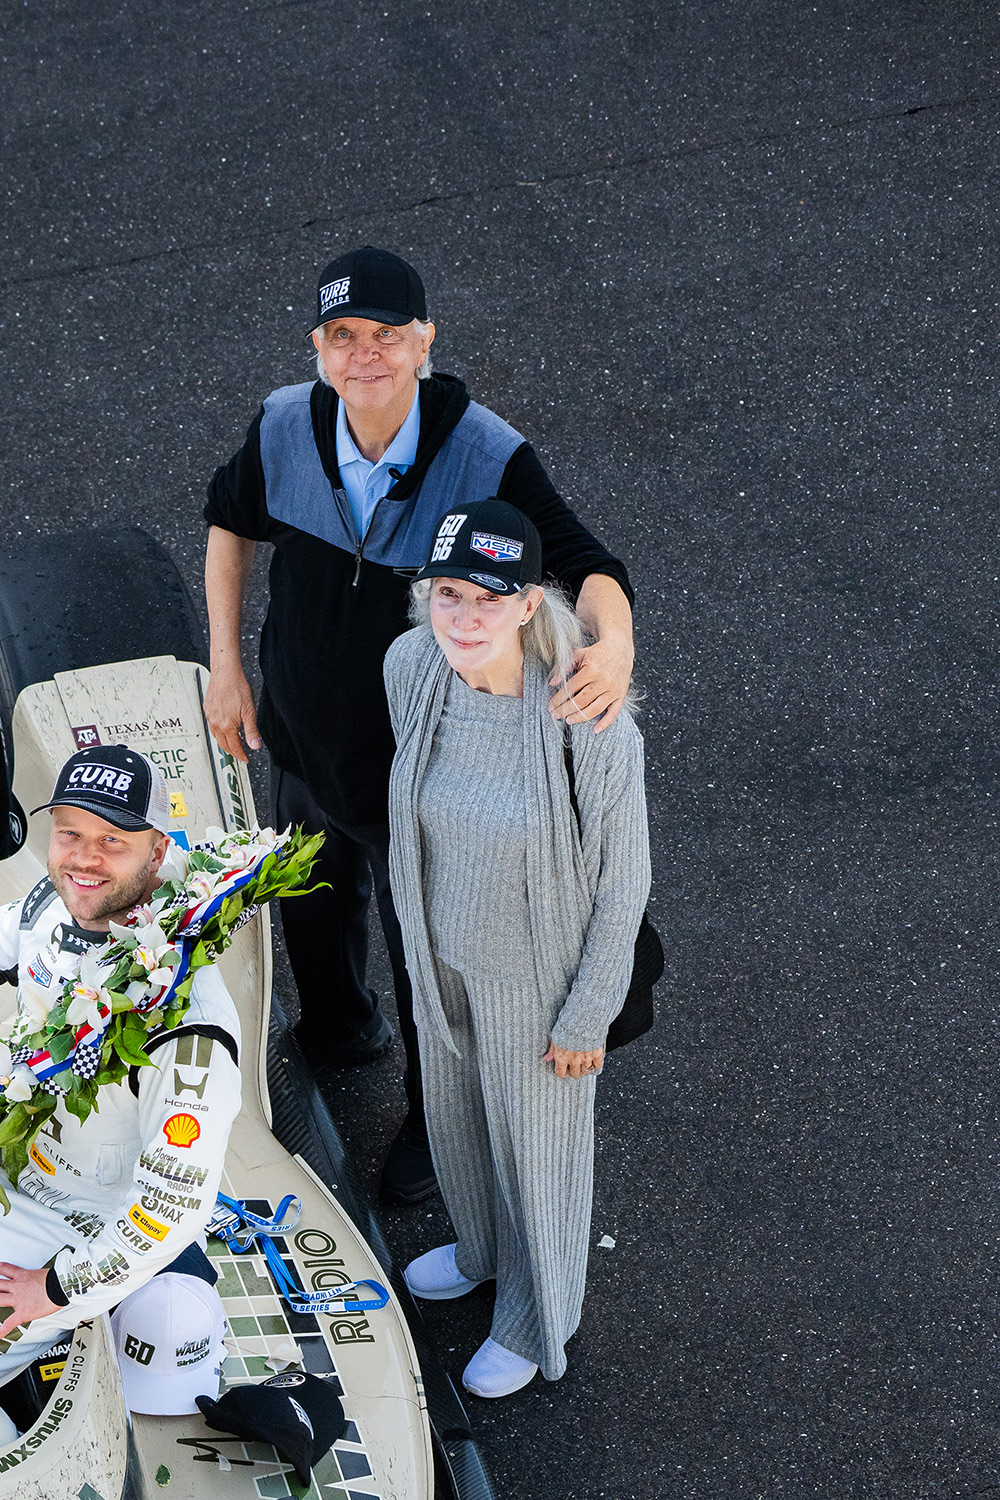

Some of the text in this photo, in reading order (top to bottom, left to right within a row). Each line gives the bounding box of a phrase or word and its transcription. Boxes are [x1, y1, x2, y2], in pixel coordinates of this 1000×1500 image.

[320, 280, 350, 305] CURB
[437, 514, 468, 537] 60
[431, 537, 456, 562] 66
[474, 538, 520, 557] MSR
[104, 717, 183, 737] TEXAS A&M
[142, 748, 188, 766] CTIC
[68, 766, 133, 792] CURB
[160, 765, 185, 780] OLF
[164, 1098, 210, 1112] Honda
[43, 1142, 82, 1178] CLIFFS
[152, 1147, 178, 1167] Morgan
[138, 1150, 210, 1188] WALLEN
[167, 1181, 194, 1194] RADIO
[157, 1203, 185, 1225] MAX
[115, 1219, 153, 1253] CURB
[139, 1217, 163, 1236] Clopay
[329, 1287, 343, 1299] NTT
[300, 1303, 330, 1312] SERIES
[123, 1333, 156, 1367] 60
[175, 1335, 211, 1358] WALLEN
[176, 1349, 211, 1368] SiriusXM
[63, 1355, 85, 1392] CLIFFS
